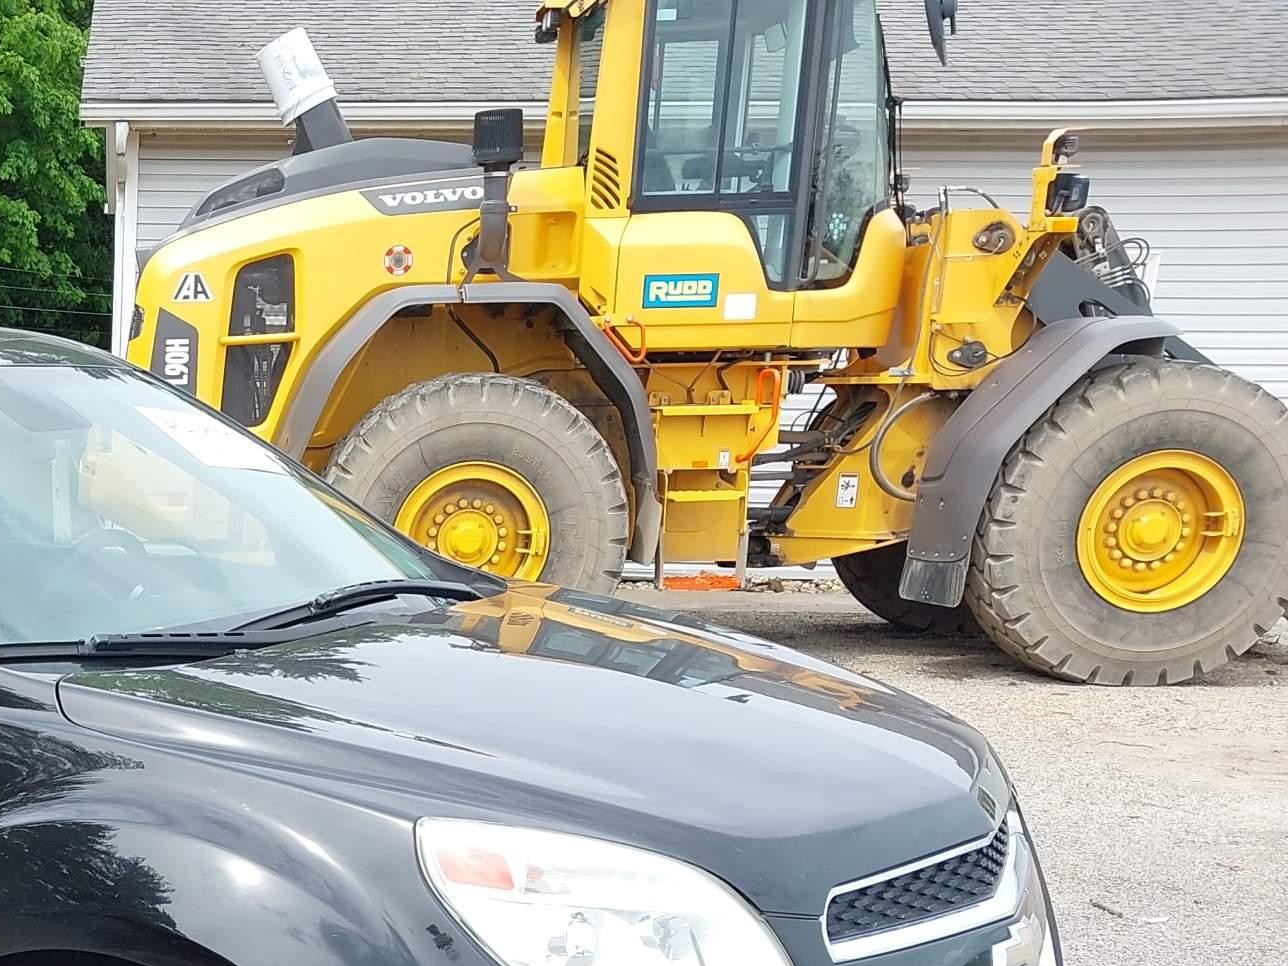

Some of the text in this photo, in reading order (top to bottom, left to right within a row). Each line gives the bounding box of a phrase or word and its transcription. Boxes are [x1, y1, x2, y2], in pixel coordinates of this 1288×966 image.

[378, 186, 484, 207] VOLVO
[648, 279, 713, 302] RUDD
[164, 338, 190, 386] L90H
